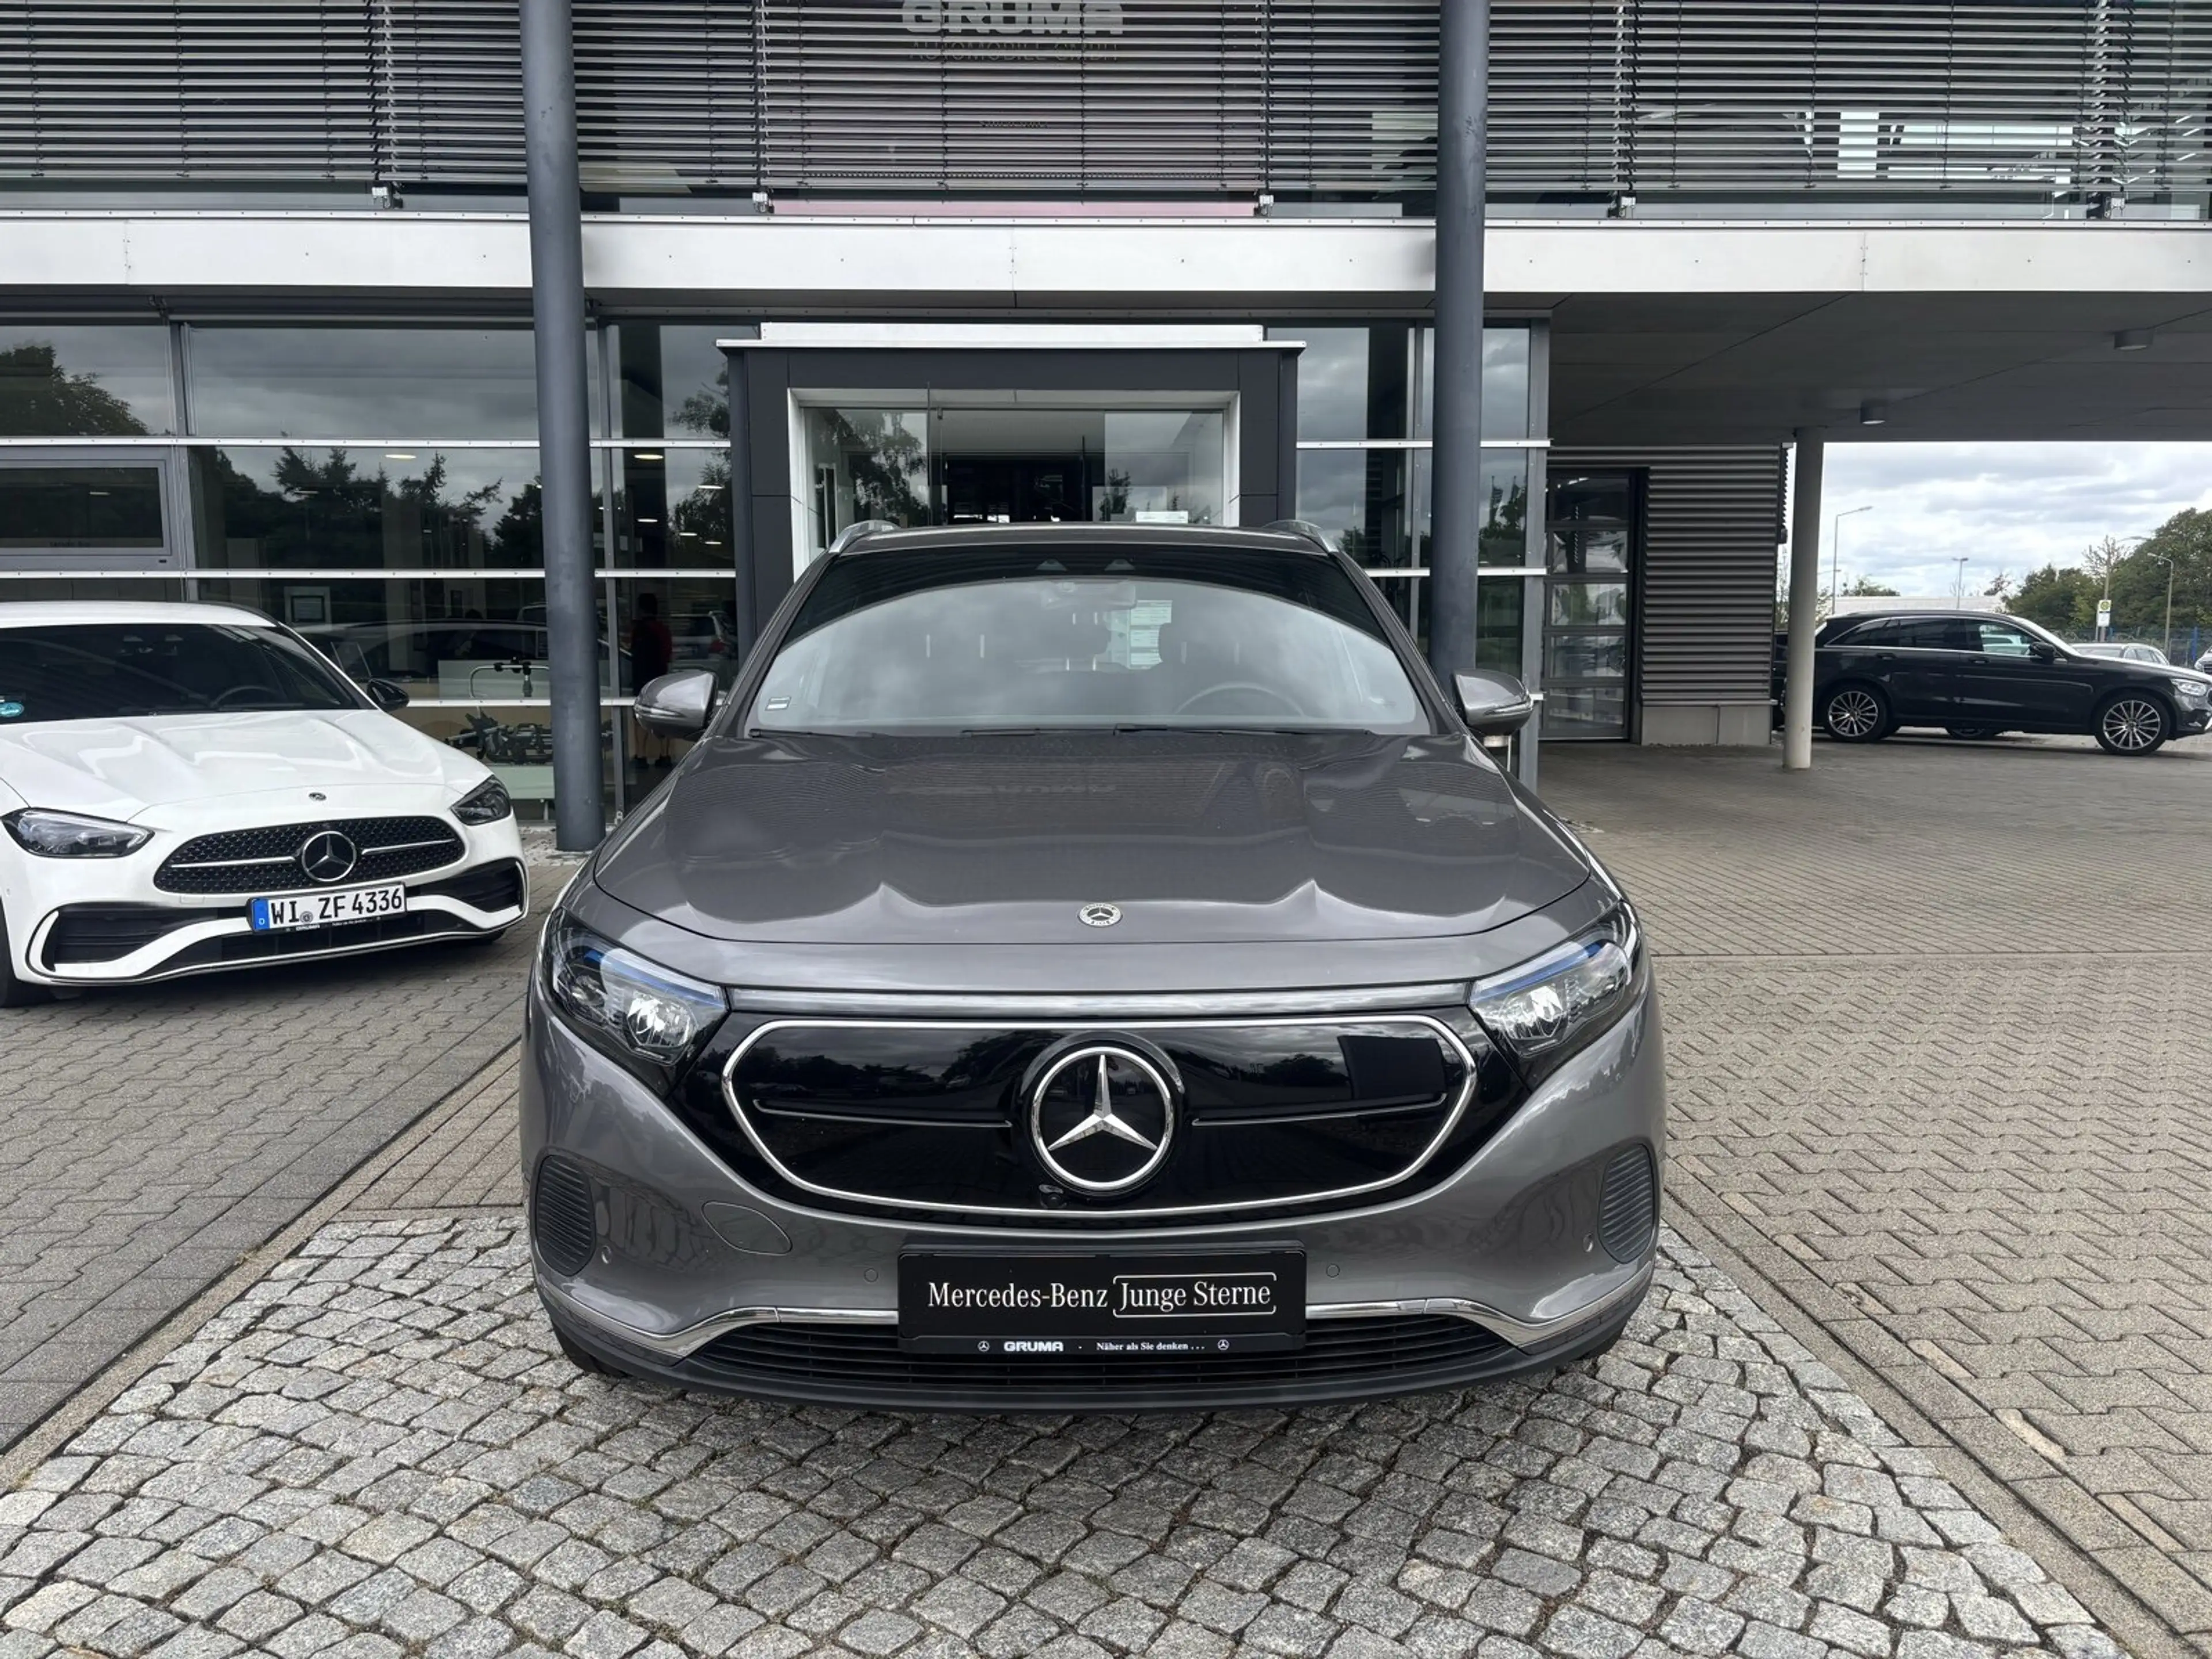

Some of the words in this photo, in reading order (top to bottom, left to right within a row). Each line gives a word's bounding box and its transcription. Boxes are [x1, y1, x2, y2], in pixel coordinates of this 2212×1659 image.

[902, 0, 1123, 34] GRUMA
[271, 901, 299, 924] WI
[318, 896, 346, 919] ZF
[352, 888, 402, 914] 4336
[928, 1282, 1108, 1308] Mercedes-Benz
[1120, 1283, 1186, 1313] Junge
[1193, 1281, 1270, 1306] Sterne
[1003, 1340, 1064, 1352] GRUMA
[1096, 1342, 1124, 1351] Näher
[1126, 1342, 1139, 1351] als
[1140, 1342, 1154, 1350] Sie
[1156, 1341, 1188, 1350] denken
